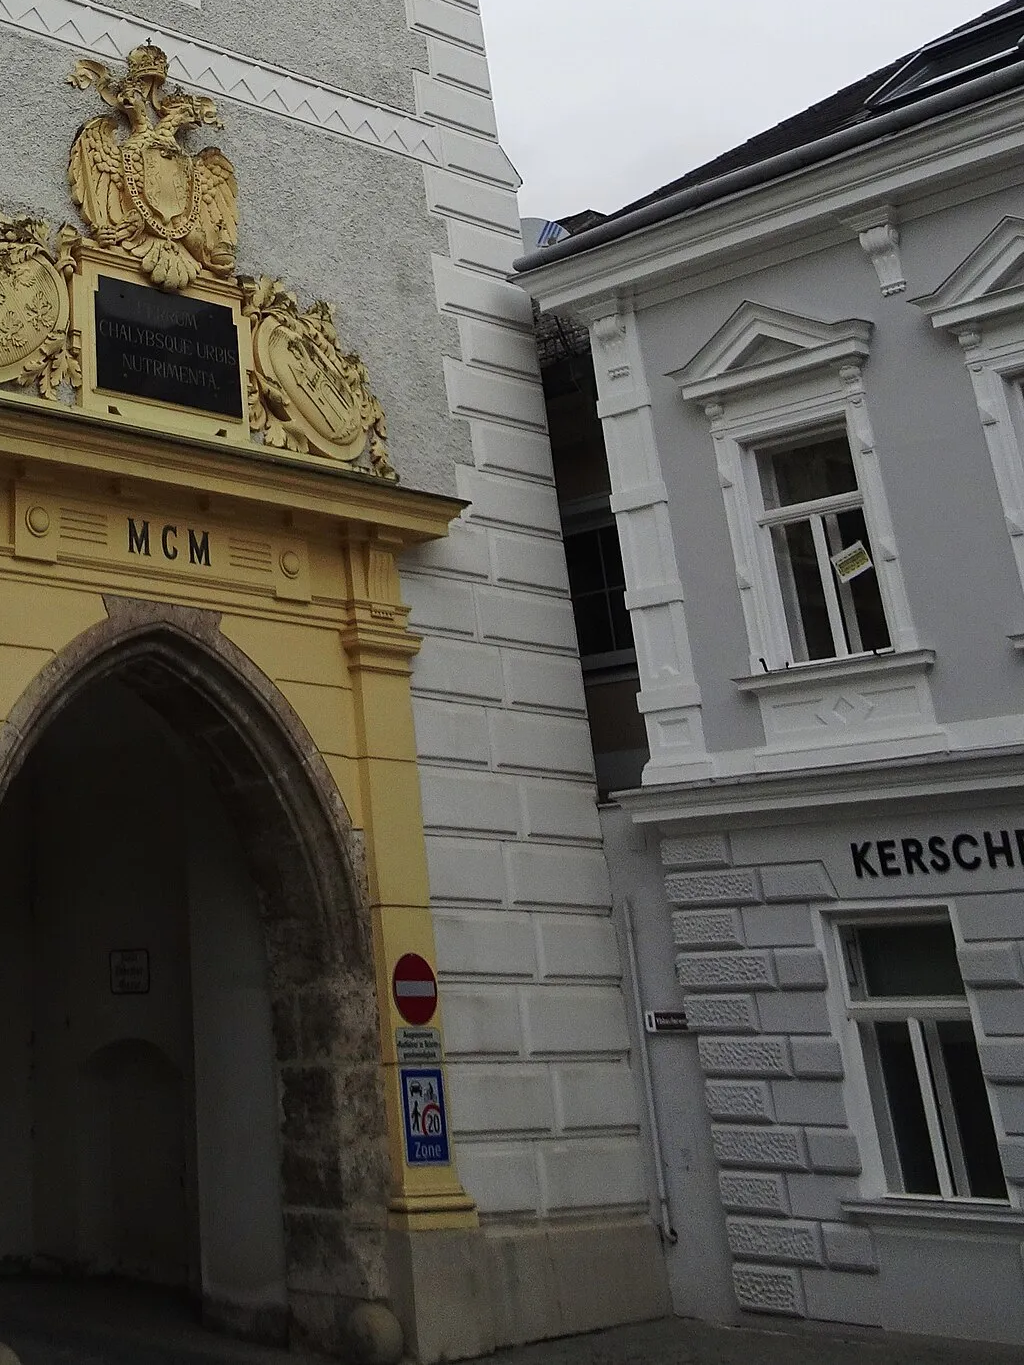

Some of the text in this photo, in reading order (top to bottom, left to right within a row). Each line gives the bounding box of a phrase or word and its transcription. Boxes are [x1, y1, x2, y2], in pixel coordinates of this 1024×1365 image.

[99, 318, 236, 366] CHALYBSQUE URBIS
[127, 517, 212, 567] MCM
[428, 1113, 440, 1133] 20
[414, 1141, 442, 1160] Zone
